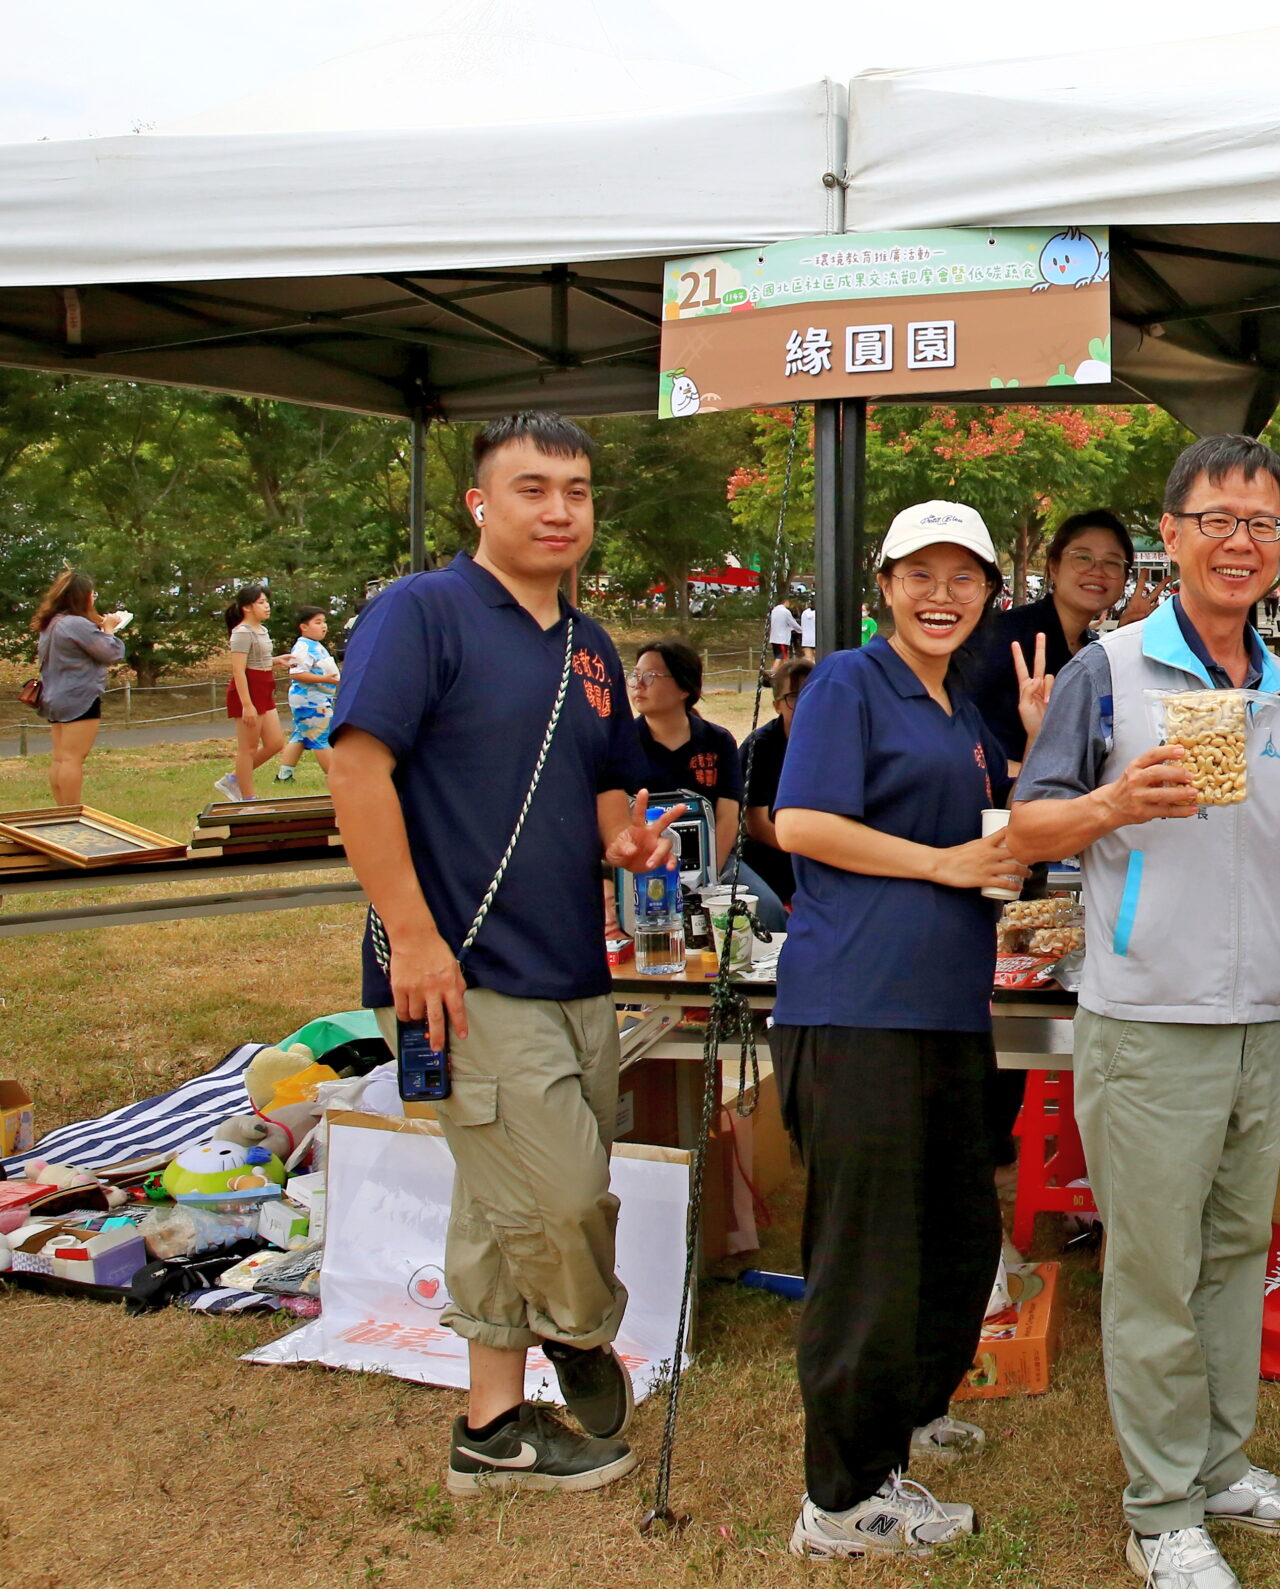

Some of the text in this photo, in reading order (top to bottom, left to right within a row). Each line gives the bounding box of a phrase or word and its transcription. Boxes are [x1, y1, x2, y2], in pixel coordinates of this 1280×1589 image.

[679, 268, 722, 310] 21
[784, 319, 957, 377] 緣圓園
